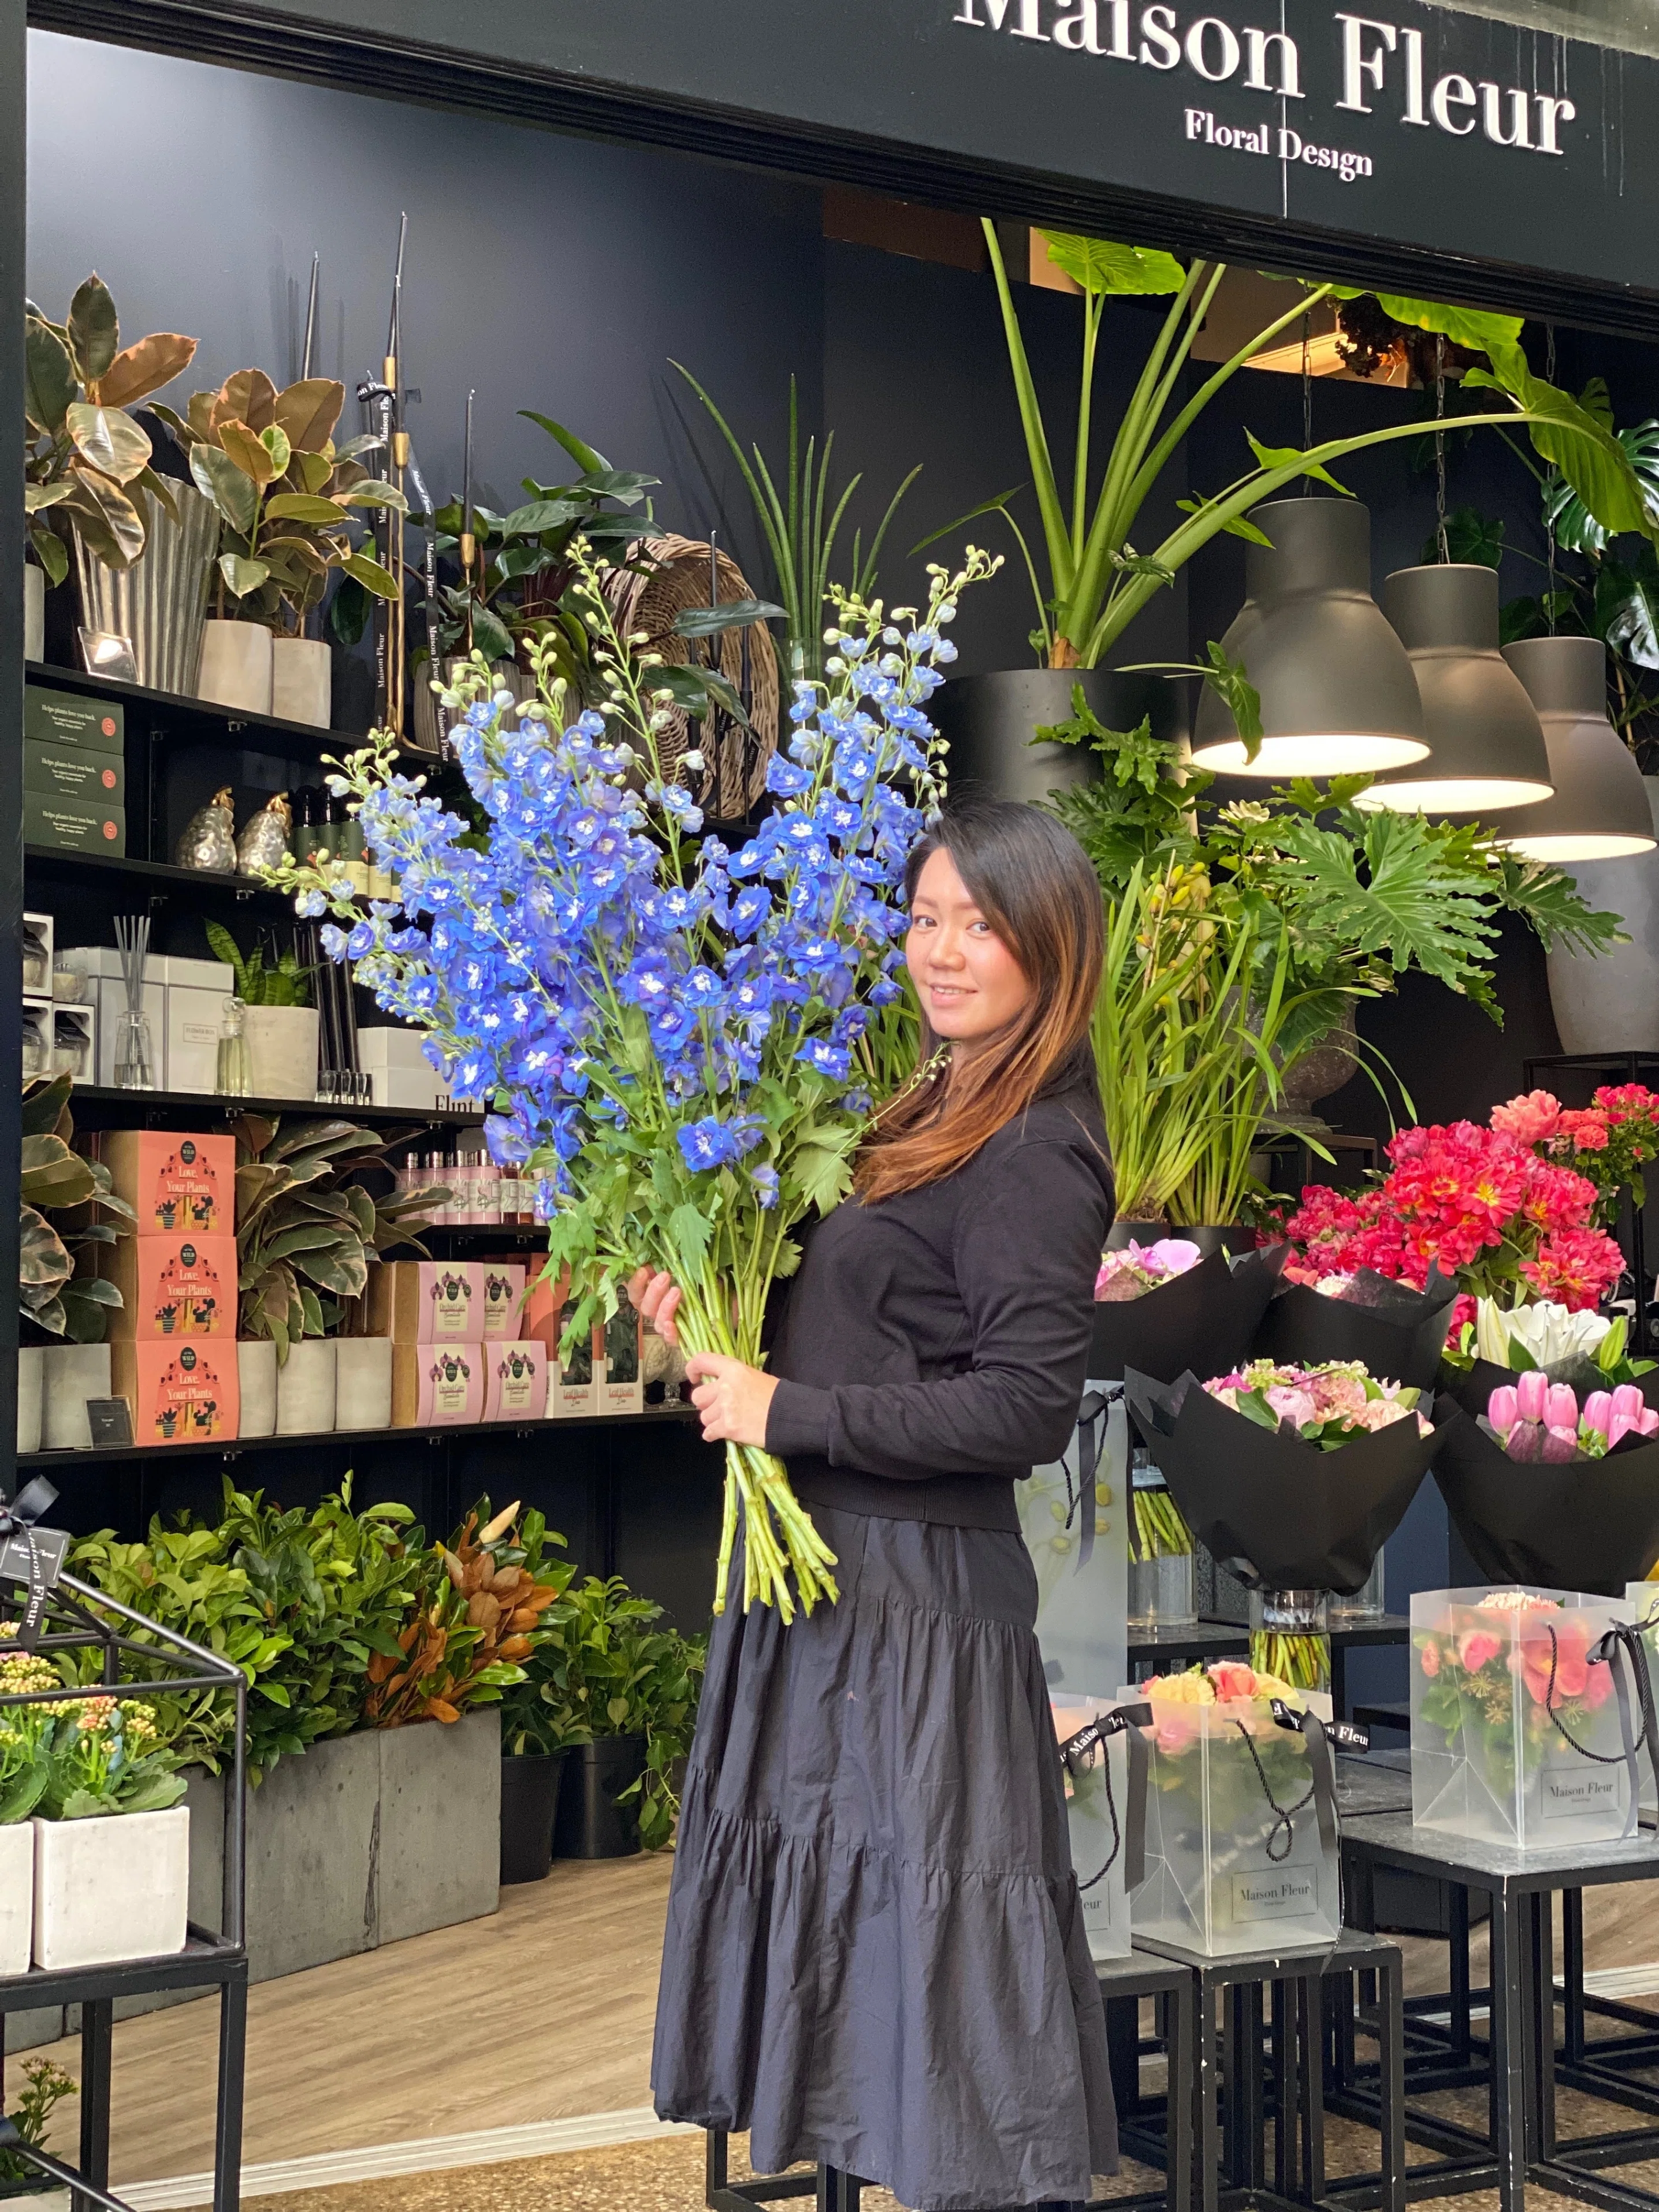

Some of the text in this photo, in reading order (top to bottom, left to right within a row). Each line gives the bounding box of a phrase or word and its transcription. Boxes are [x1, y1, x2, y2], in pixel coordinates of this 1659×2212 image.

[1334, 13, 1576, 155] Fleur
[1185, 109, 1373, 182] Floral Design
[380, 412, 389, 442] Maison
[422, 494, 432, 515] Fleur
[426, 542, 435, 598] Maison Fleur
[376, 633, 385, 656] Fleur
[429, 625, 440, 680] Maison Fleur
[437, 707, 449, 762] Maison Fleur
[435, 1094, 475, 1112] Flint
[166, 1180, 210, 1193] Your Plants
[167, 1284, 212, 1297] Your Plants
[166, 1387, 213, 1401] Your Plants
[27, 1585, 44, 1628] Fleur
[1069, 1727, 1099, 1757] Maiso
[1550, 1782, 1613, 1797] Maison Fleur
[1241, 1883, 1311, 1901] Maison Fleur
[1083, 1900, 1102, 1910] eur
